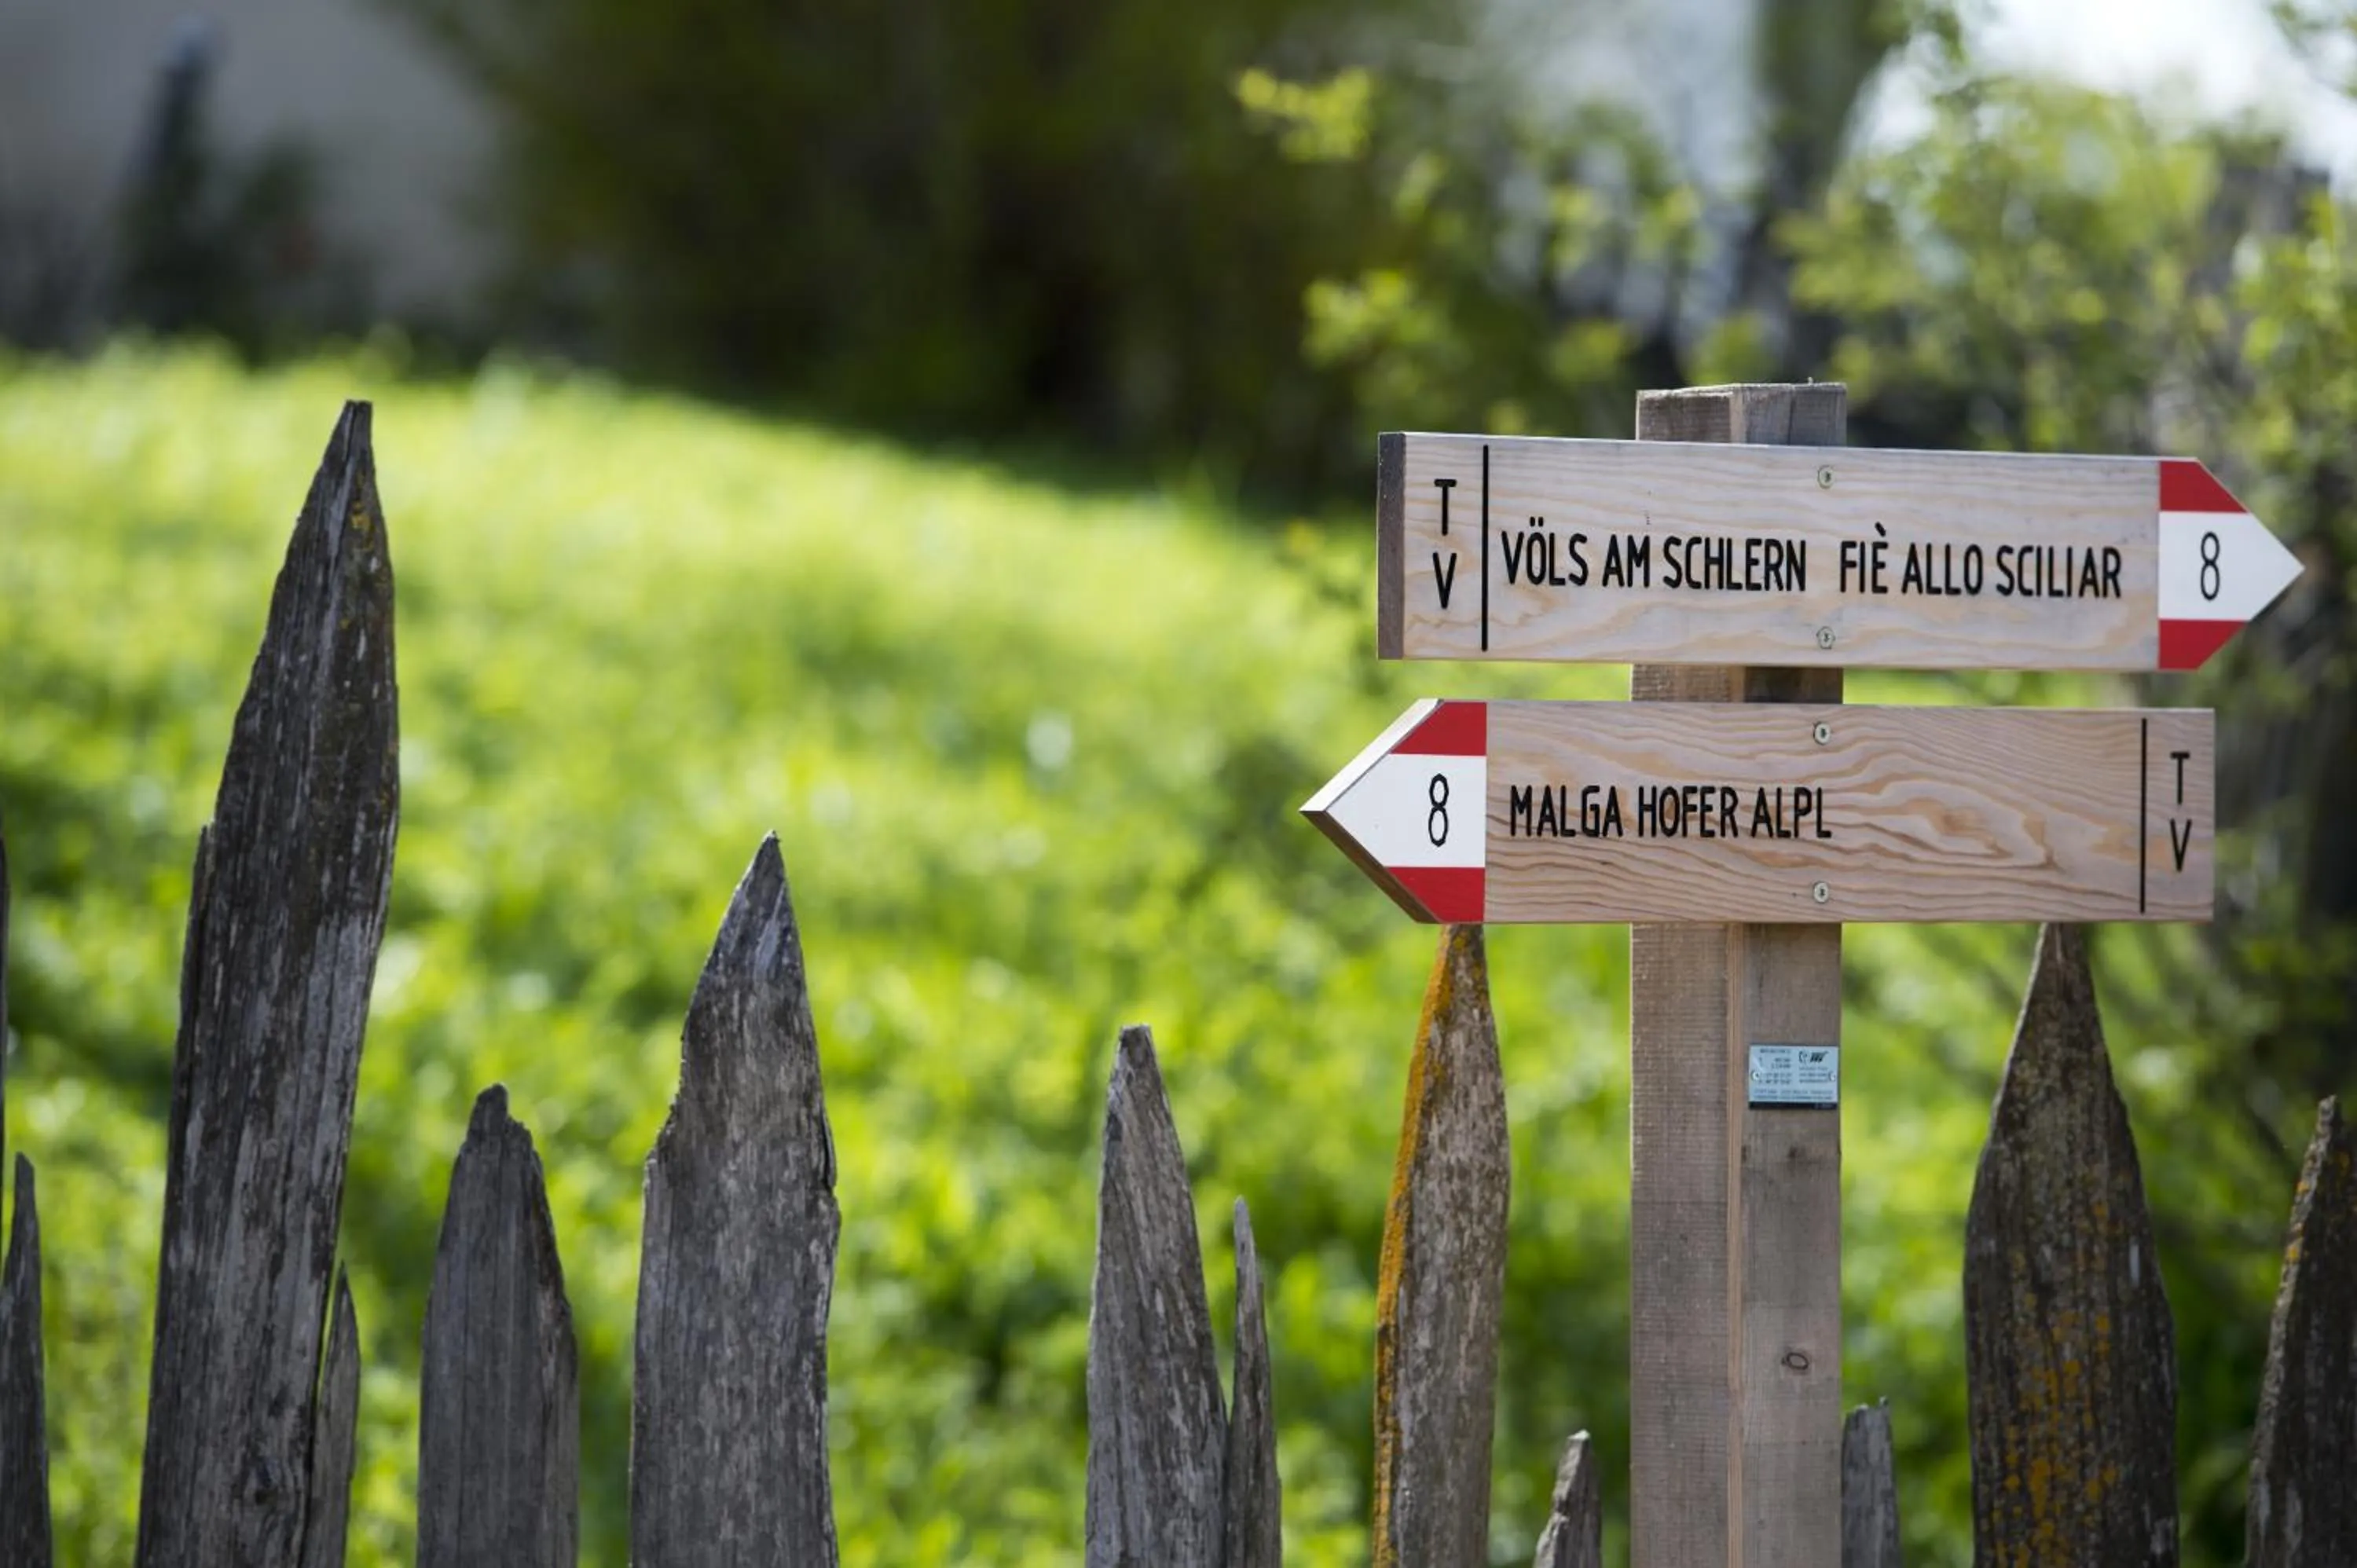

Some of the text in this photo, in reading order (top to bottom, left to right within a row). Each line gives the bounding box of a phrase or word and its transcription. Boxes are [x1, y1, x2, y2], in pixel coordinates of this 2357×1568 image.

[1434, 478, 1457, 537] T
[1432, 551, 1457, 610] V
[1500, 516, 2122, 599] VÖLS AM SCHLERN FIÈ ALLO SCILIAR
[2199, 531, 2221, 602] 8
[2170, 751, 2190, 805] T
[1427, 772, 1450, 848] 8
[1508, 784, 1833, 841] MALGA HOFER ALPL
[2169, 818, 2193, 873] V
